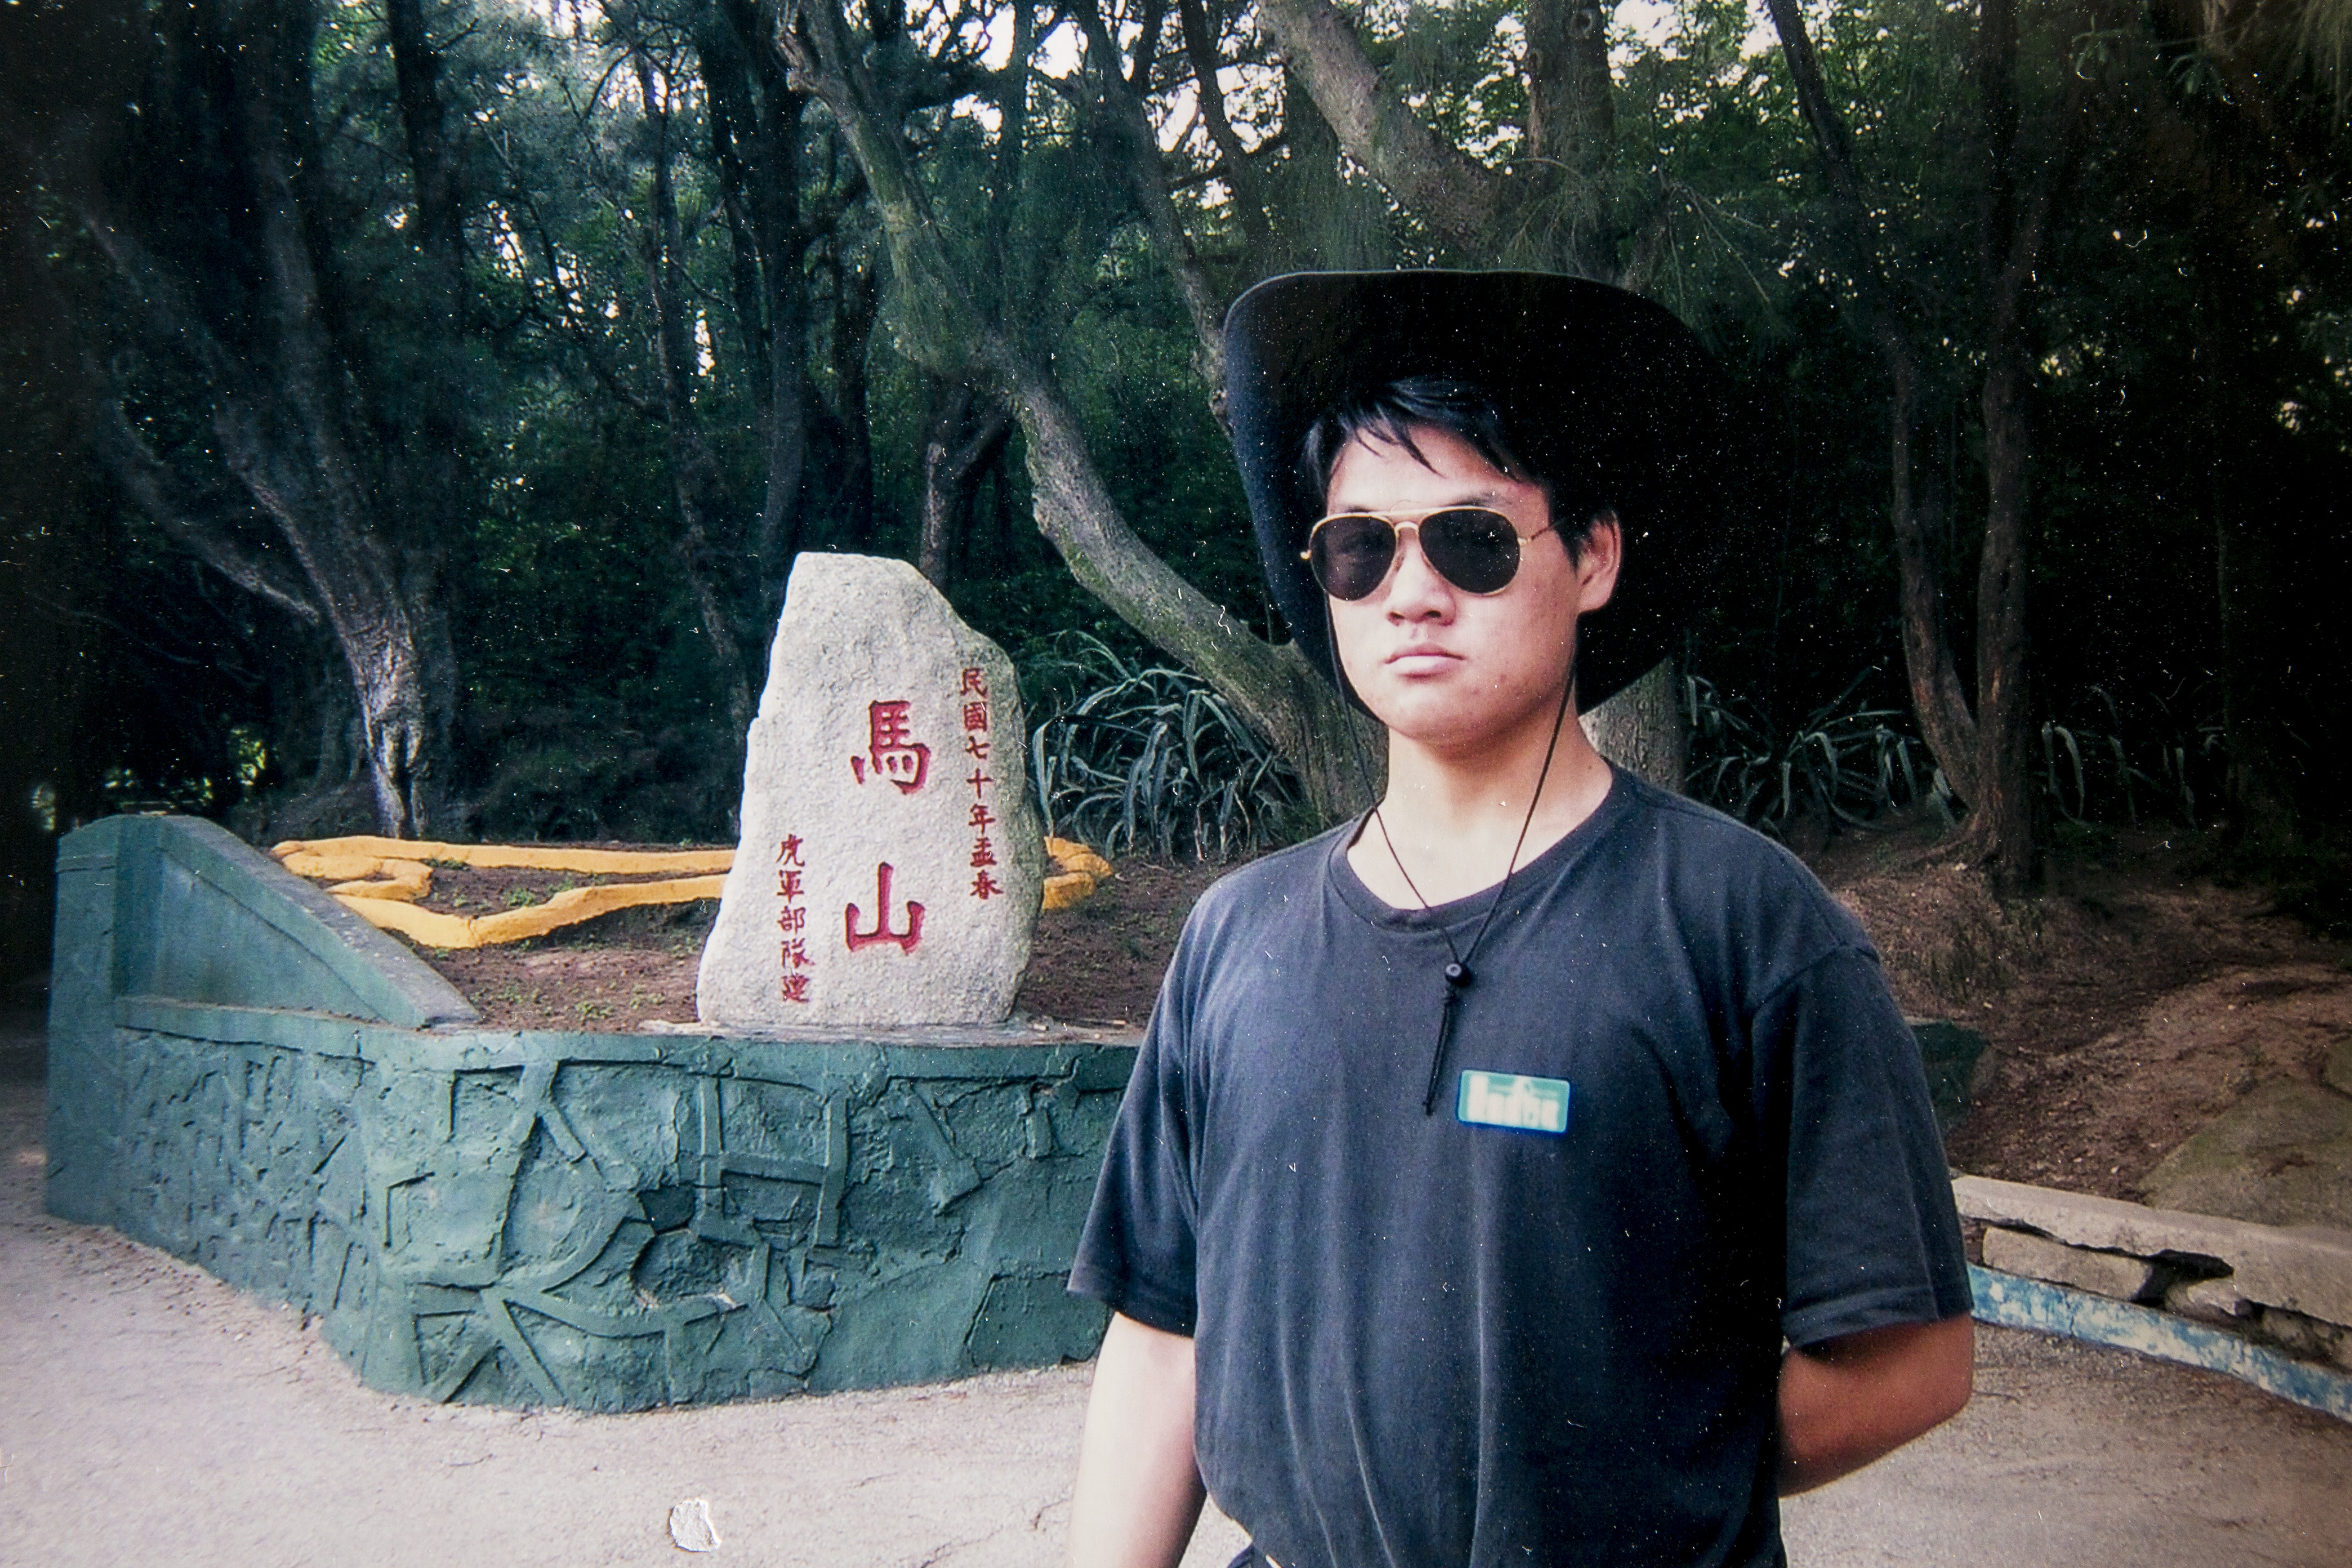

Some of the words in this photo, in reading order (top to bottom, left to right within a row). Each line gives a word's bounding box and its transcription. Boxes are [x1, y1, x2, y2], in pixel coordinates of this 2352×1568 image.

[845, 700, 931, 954] 馬山
[960, 667, 1003, 901] 民國七十年孟春
